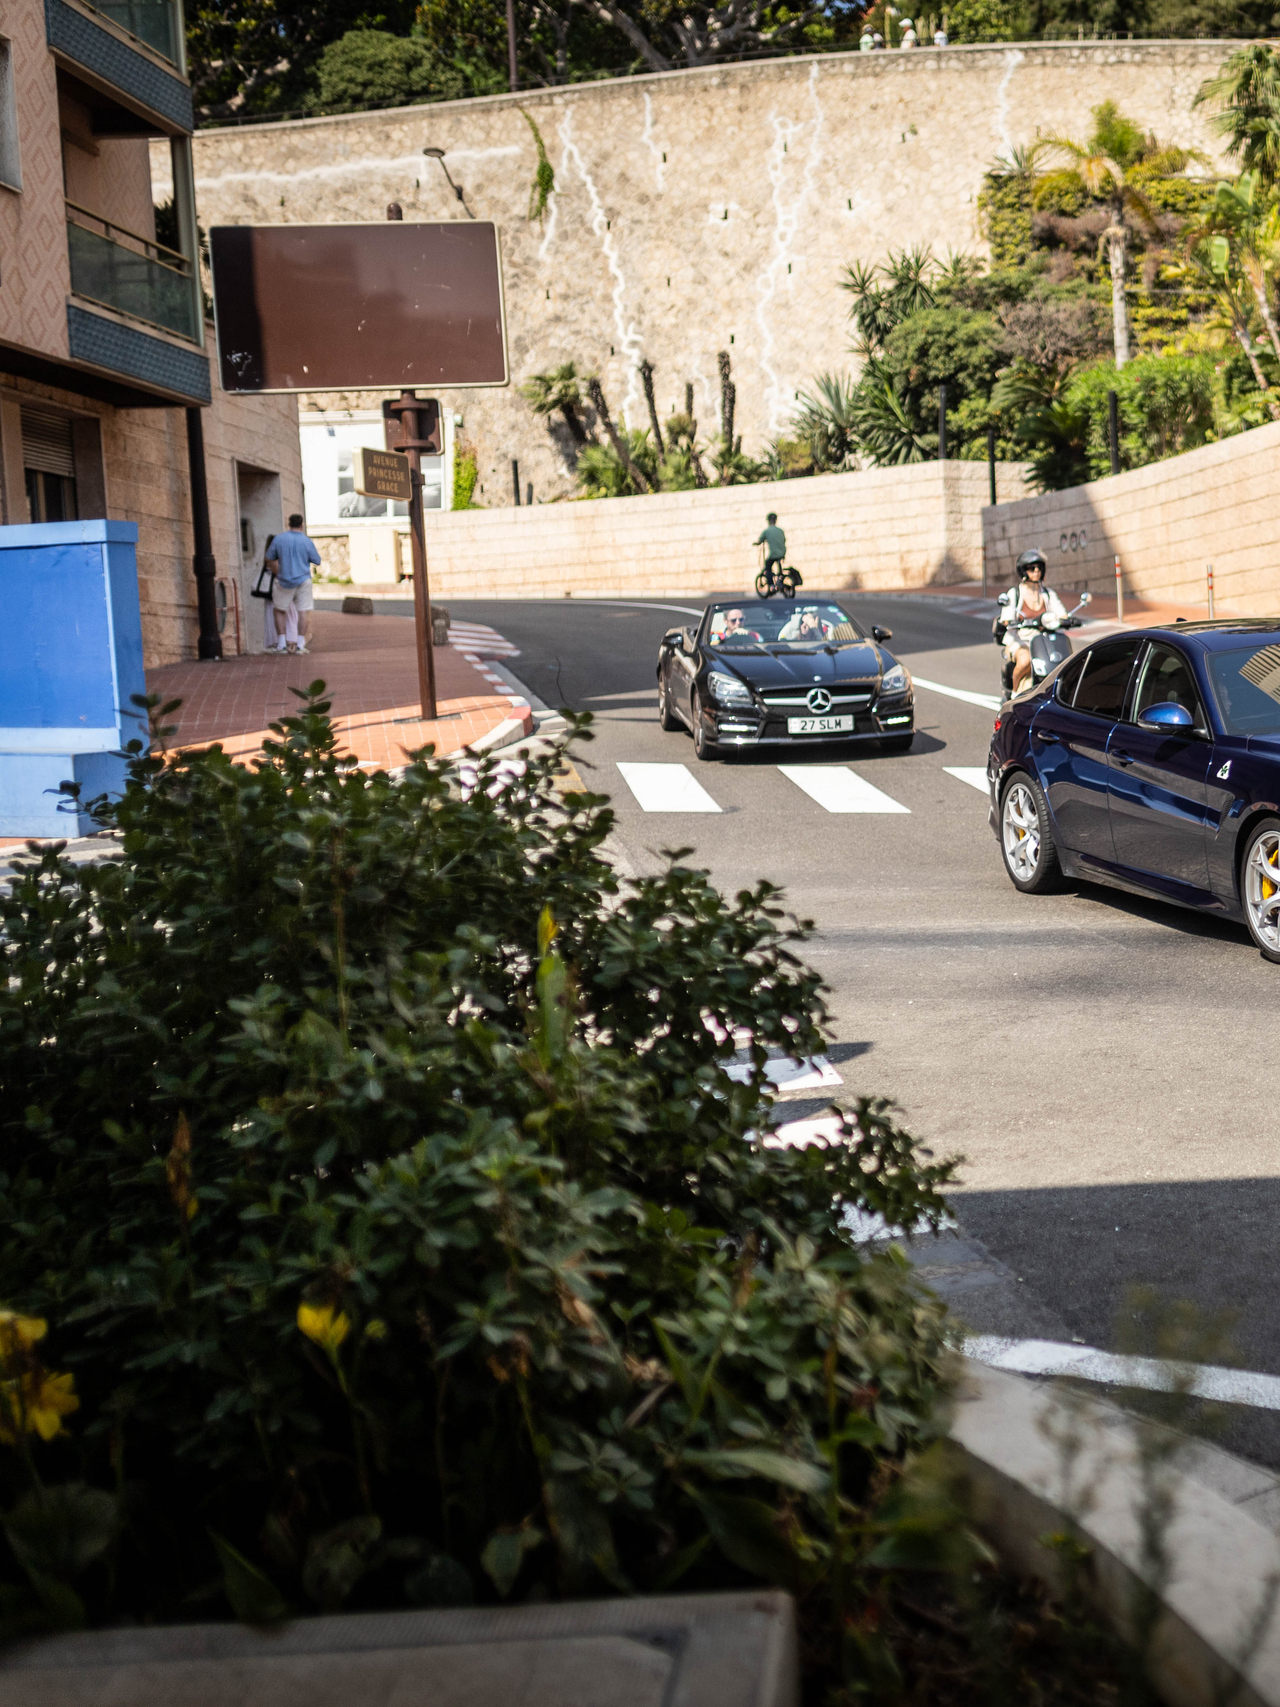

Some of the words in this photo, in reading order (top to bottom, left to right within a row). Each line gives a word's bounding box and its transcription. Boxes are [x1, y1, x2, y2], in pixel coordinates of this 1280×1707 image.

[373, 454, 398, 468] AVENUE
[368, 466, 405, 482] PRINCESSE
[376, 481, 399, 494] GRACE
[801, 720, 815, 730] 27
[819, 718, 841, 730] SLM
